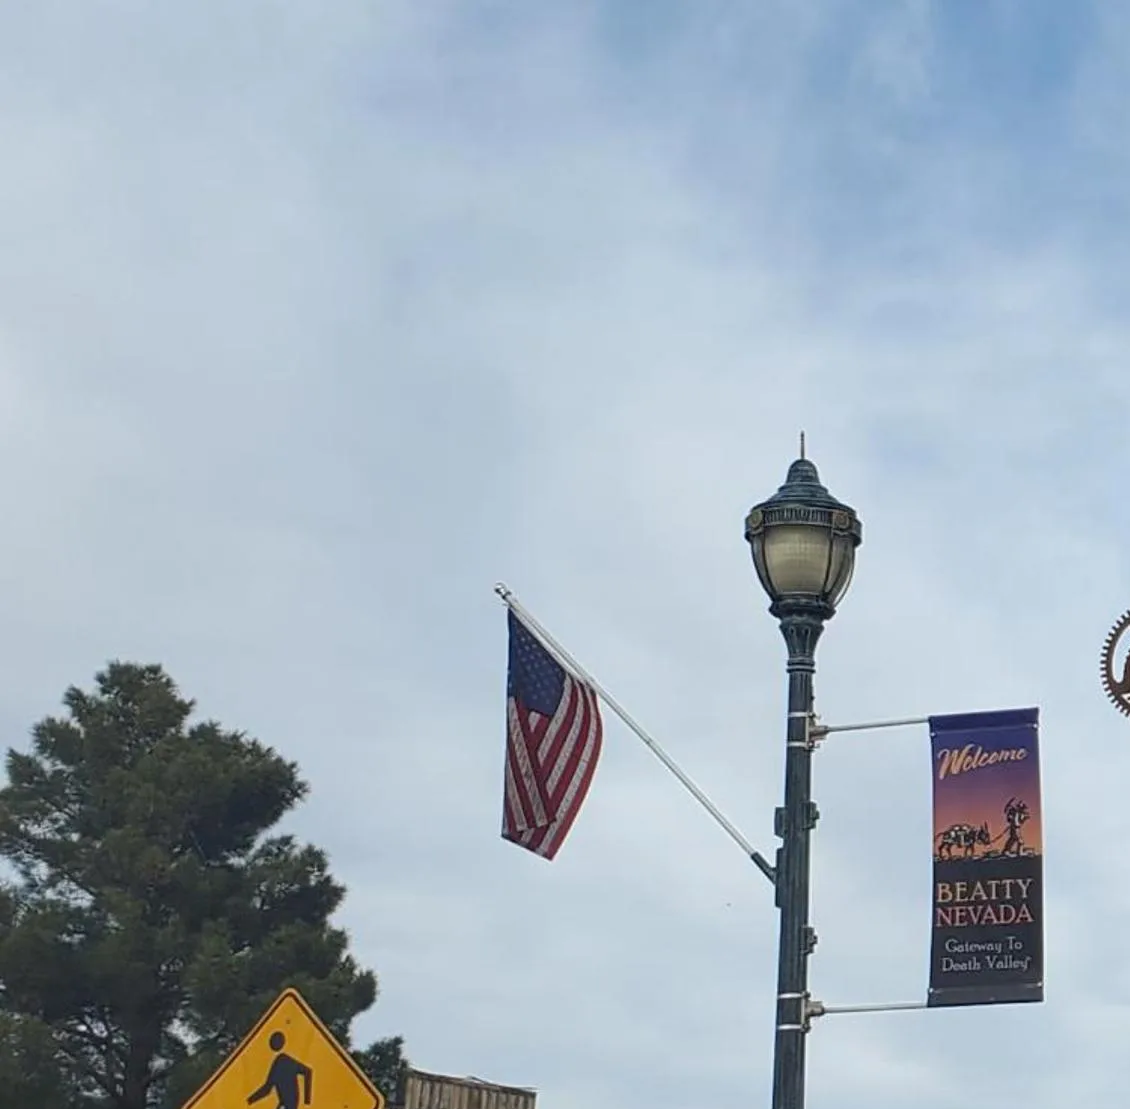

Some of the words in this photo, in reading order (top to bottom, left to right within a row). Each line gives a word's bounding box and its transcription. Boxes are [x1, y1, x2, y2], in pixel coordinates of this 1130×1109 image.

[938, 743, 1027, 780] Welcome
[936, 878, 1034, 903] BEATTY
[935, 903, 1035, 927] NEVADA
[944, 938, 1002, 953] Gateway
[1006, 936, 1024, 950] To
[941, 957, 981, 972] Death
[985, 955, 1032, 971] Valley
